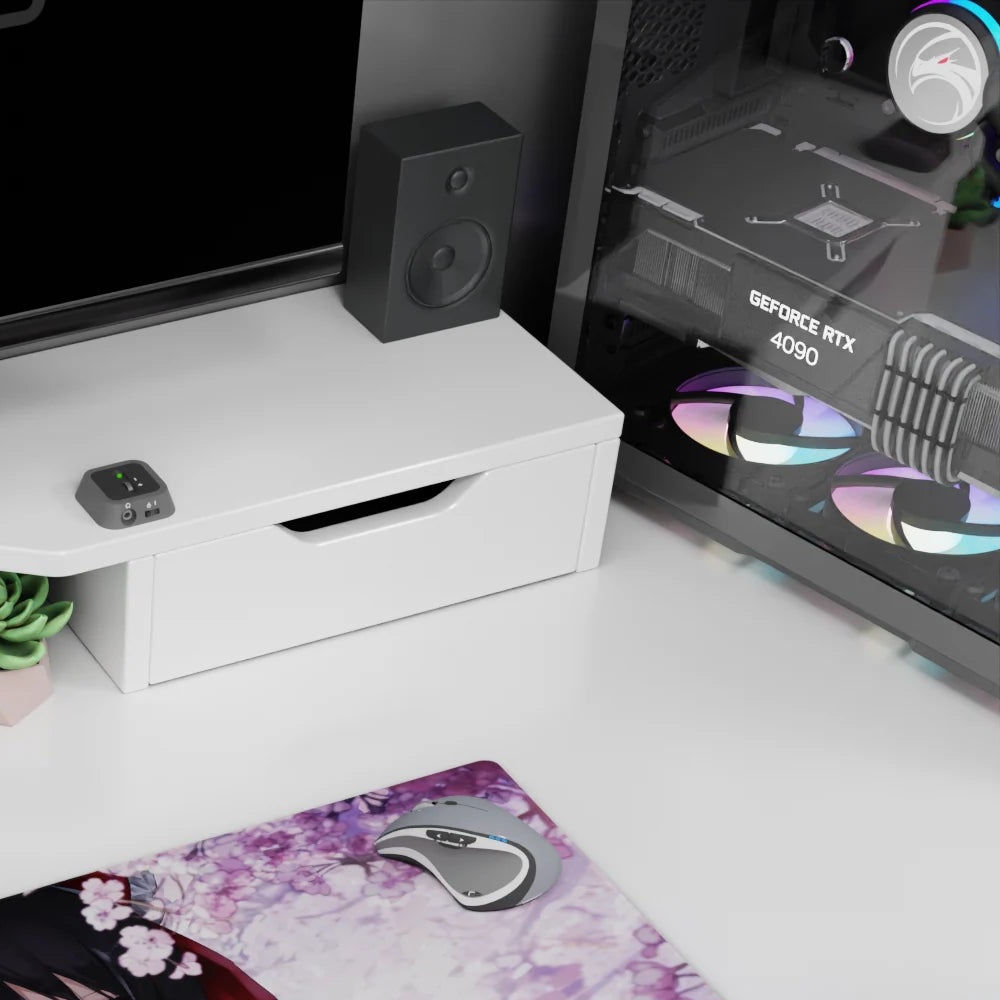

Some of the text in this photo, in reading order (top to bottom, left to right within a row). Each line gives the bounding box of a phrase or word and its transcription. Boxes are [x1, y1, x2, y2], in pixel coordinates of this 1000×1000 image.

[749, 289, 856, 354] GEFORCE RTX
[769, 331, 819, 367] 4090
